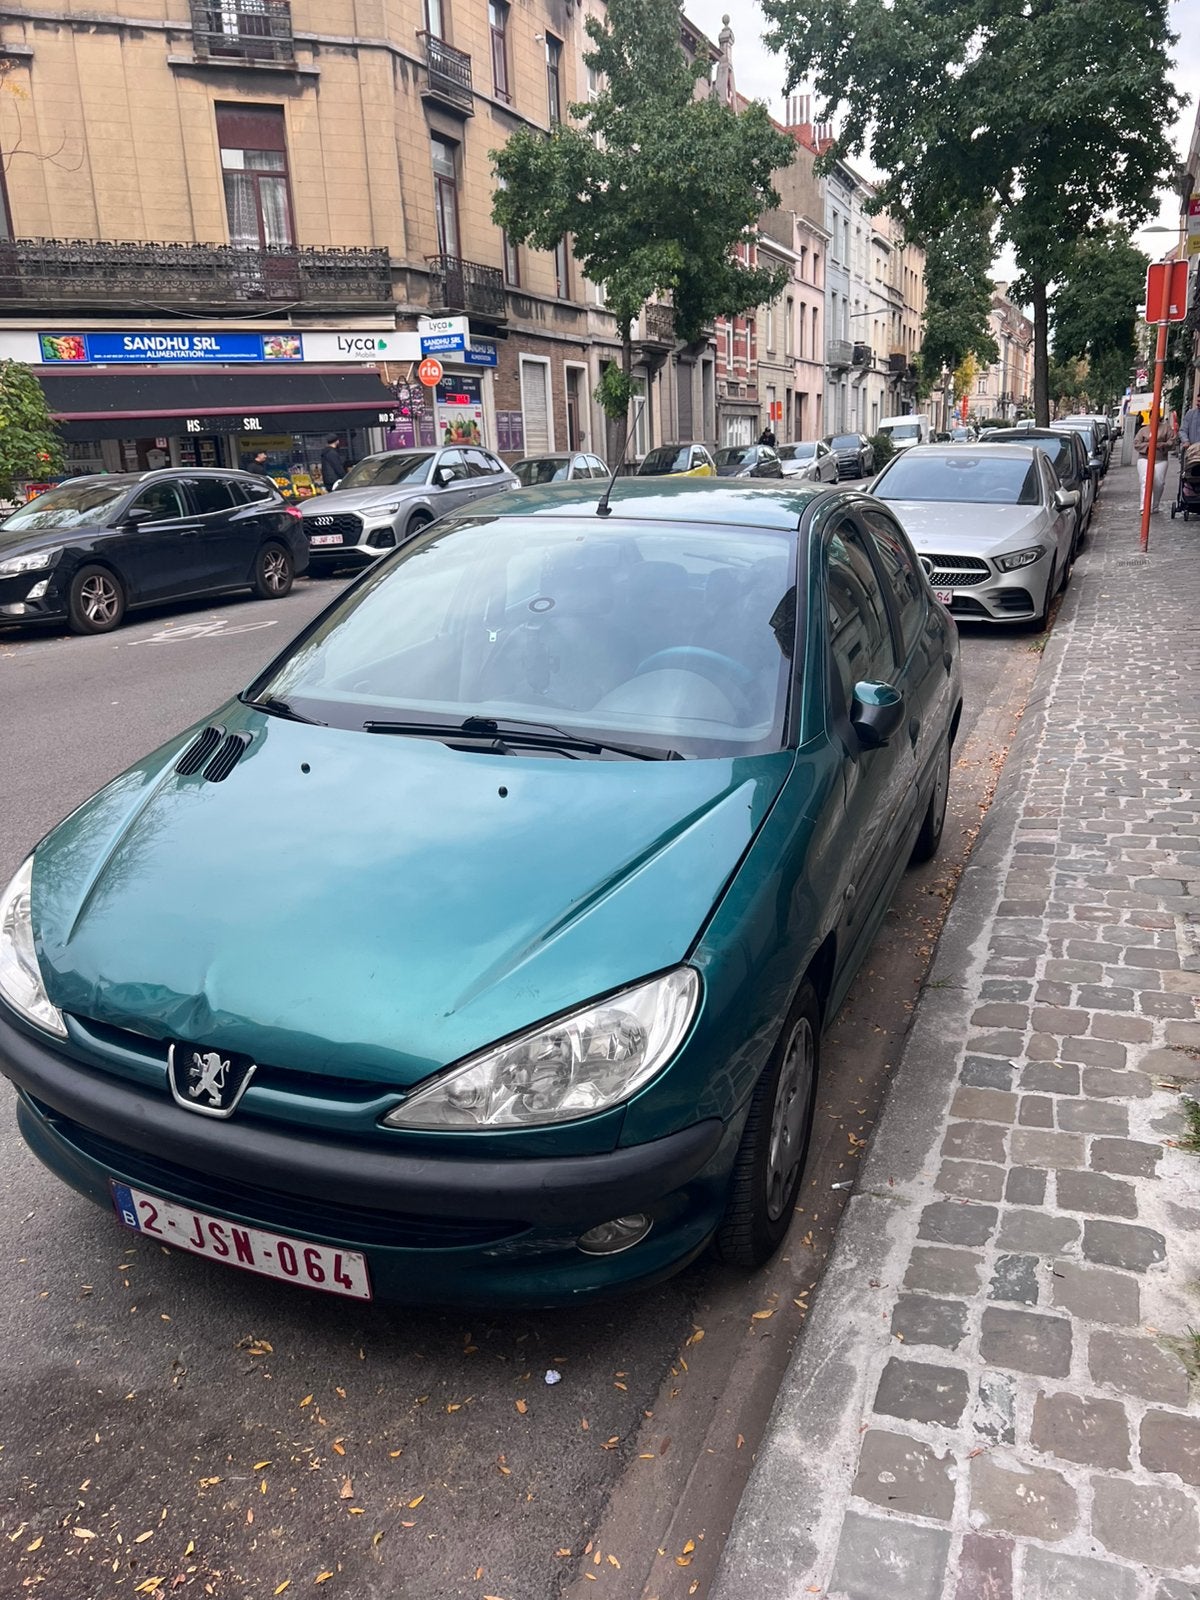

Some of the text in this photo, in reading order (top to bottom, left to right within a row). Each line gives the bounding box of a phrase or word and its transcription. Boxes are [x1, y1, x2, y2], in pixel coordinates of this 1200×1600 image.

[429, 322, 447, 331] Lyca
[123, 337, 220, 350] SANDHU SRL
[337, 336, 375, 353] Lyca
[423, 338, 450, 347] SANDHU
[146, 350, 204, 358] ALIMENTATION
[421, 362, 439, 376] ria
[243, 417, 262, 430] SRL
[379, 413, 394, 422] NO 3
[122, 1200, 353, 1290] B 2-JSN-064
